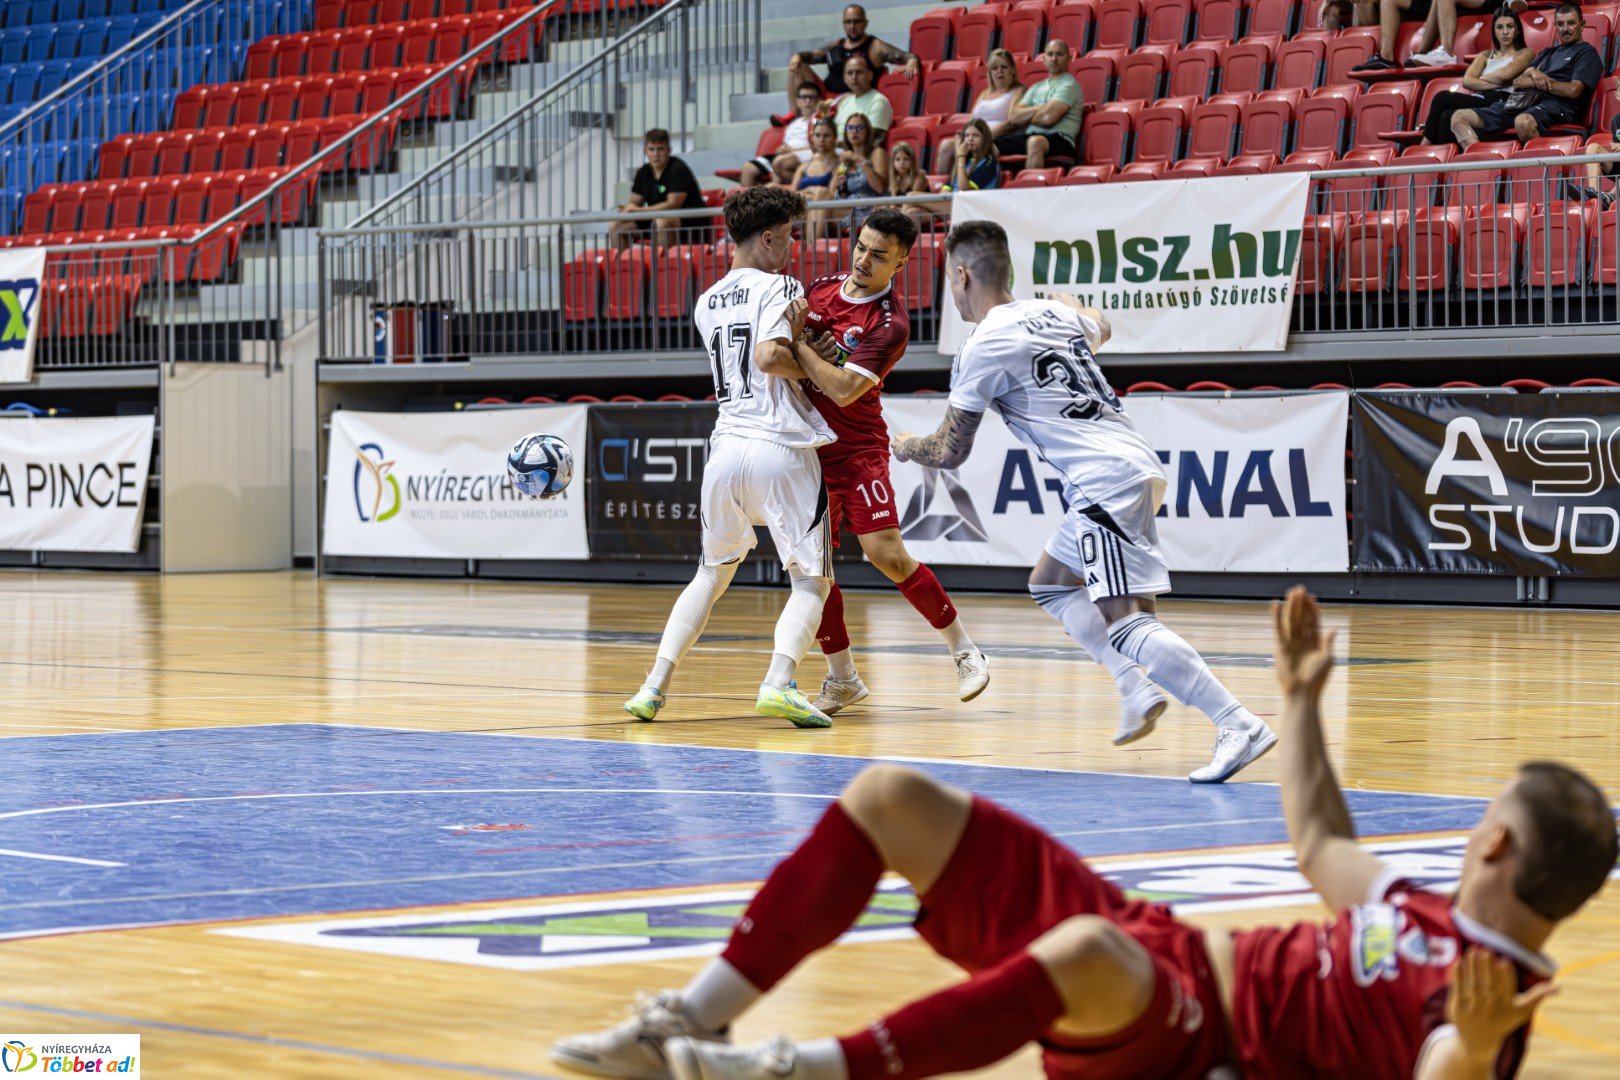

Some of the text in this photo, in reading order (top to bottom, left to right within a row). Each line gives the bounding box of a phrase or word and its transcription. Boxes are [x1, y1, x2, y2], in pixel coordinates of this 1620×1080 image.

[1033, 224, 1301, 285] mlsz.hu
[1102, 287, 1202, 310] Labdarúgó
[709, 323, 753, 403] 17
[1032, 334, 1123, 421] 30
[1425, 416, 1620, 496] A'9
[26, 462, 138, 507] PINCE
[856, 479, 889, 507] 10
[872, 510, 890, 520] JAKO
[1428, 504, 1620, 555] STUD
